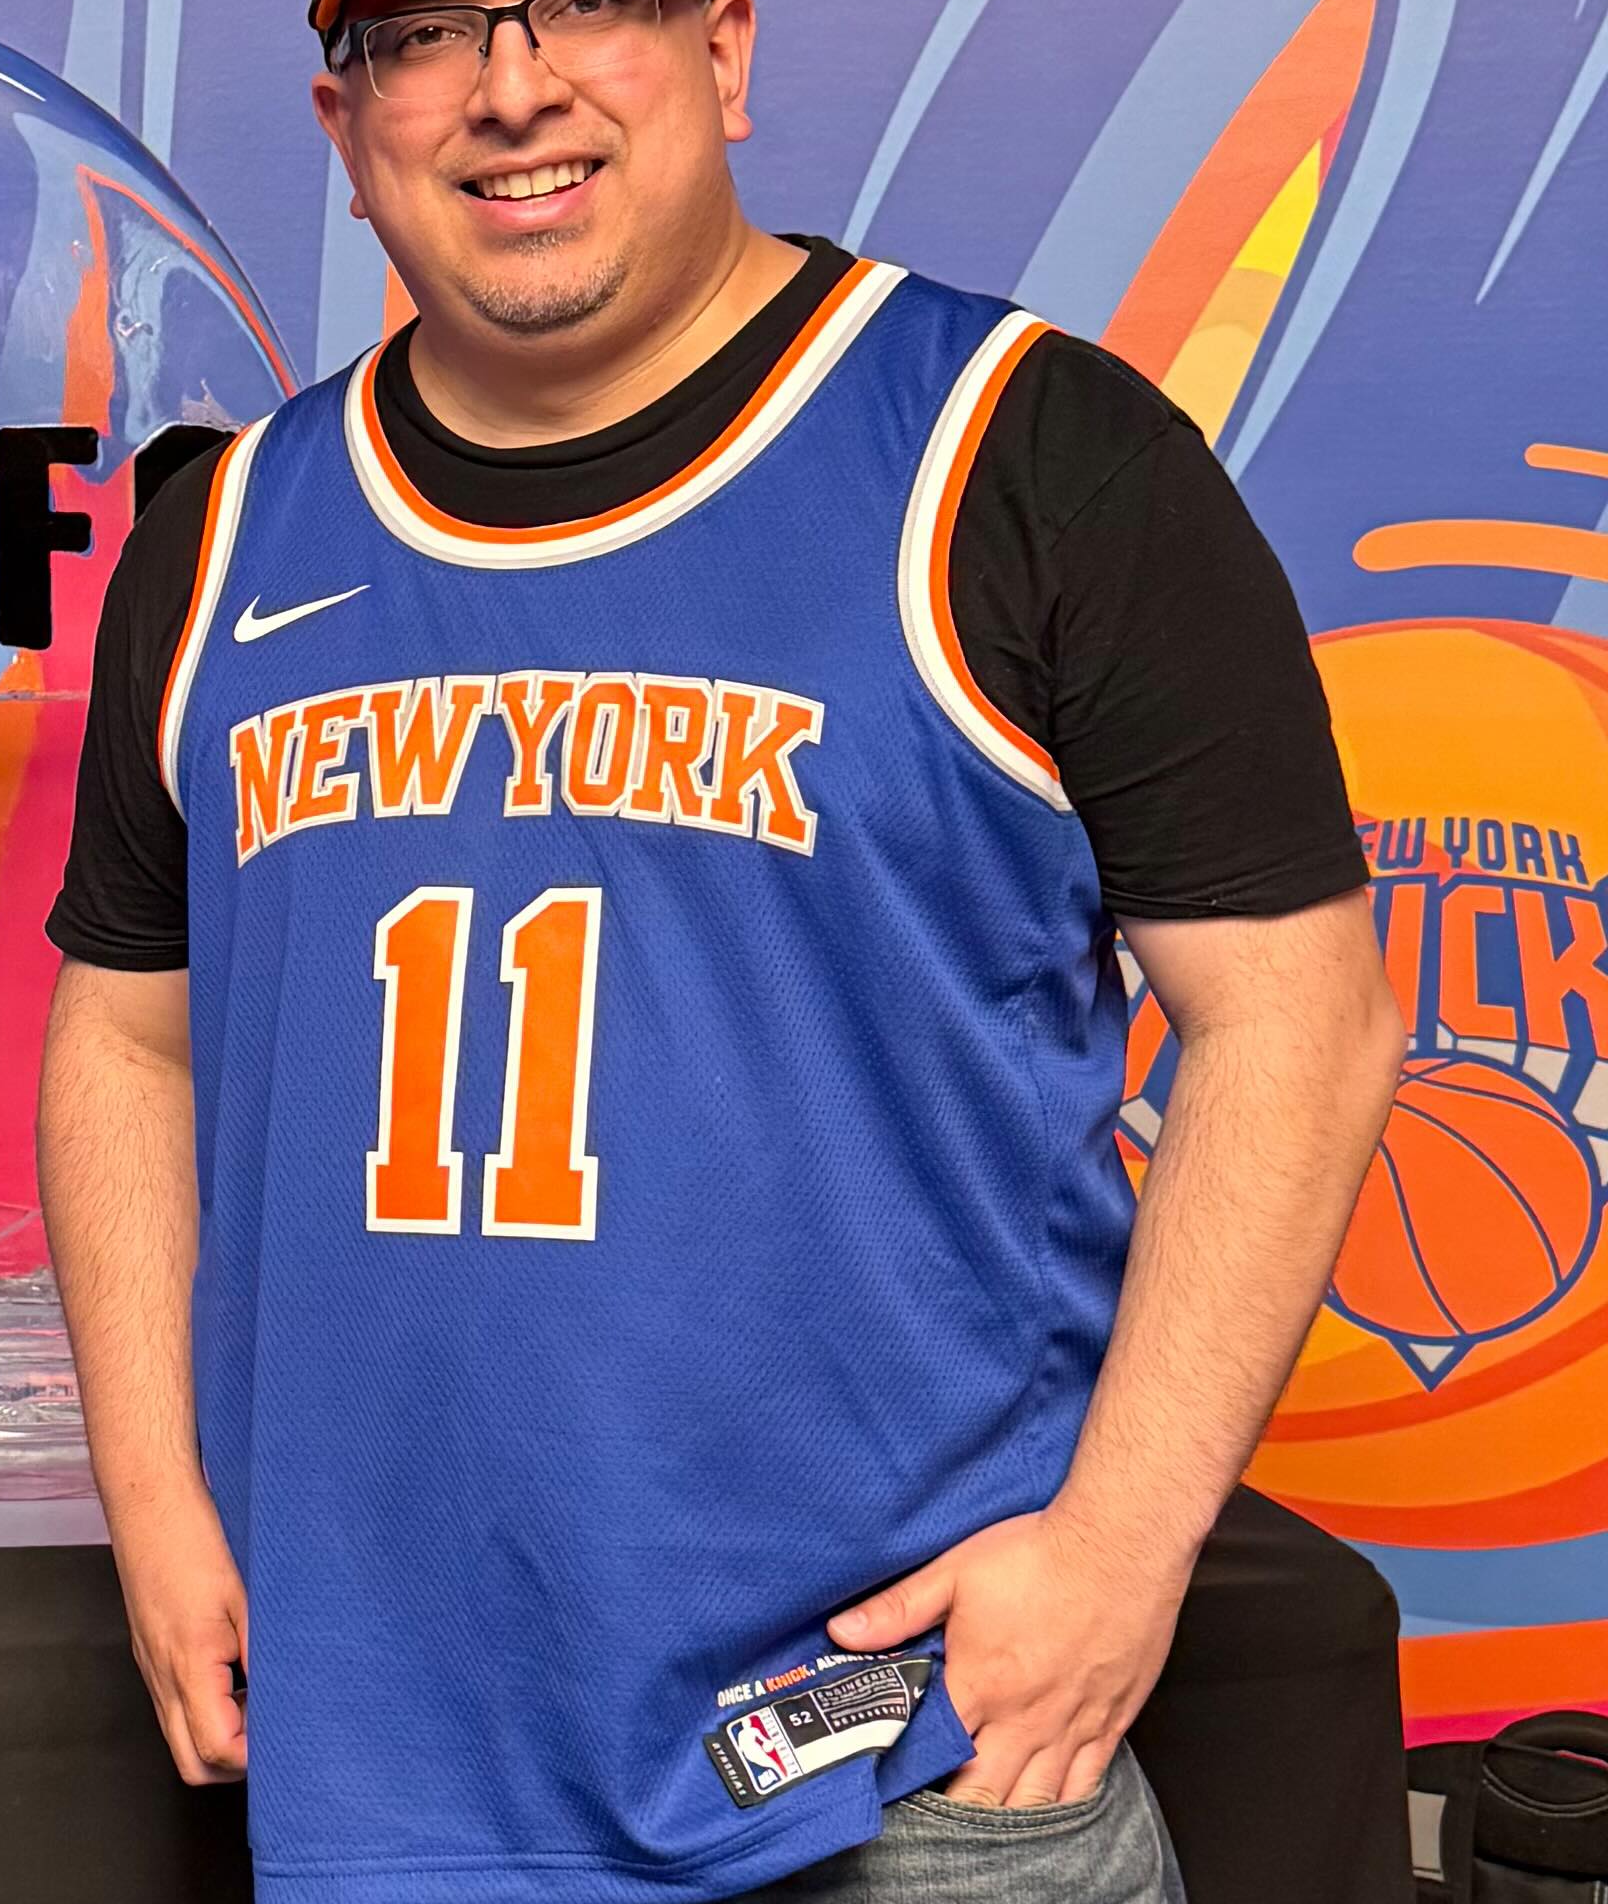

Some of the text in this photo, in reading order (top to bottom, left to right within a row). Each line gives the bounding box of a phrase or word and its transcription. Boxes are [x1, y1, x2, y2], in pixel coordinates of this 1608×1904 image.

[230, 669, 825, 869] NEW YORK
[1353, 816, 1590, 886] EW YORK
[366, 886, 603, 1241] 11
[717, 1683, 754, 1707] ONCE
[754, 1679, 767, 1697] A
[789, 1710, 814, 1727] 52
